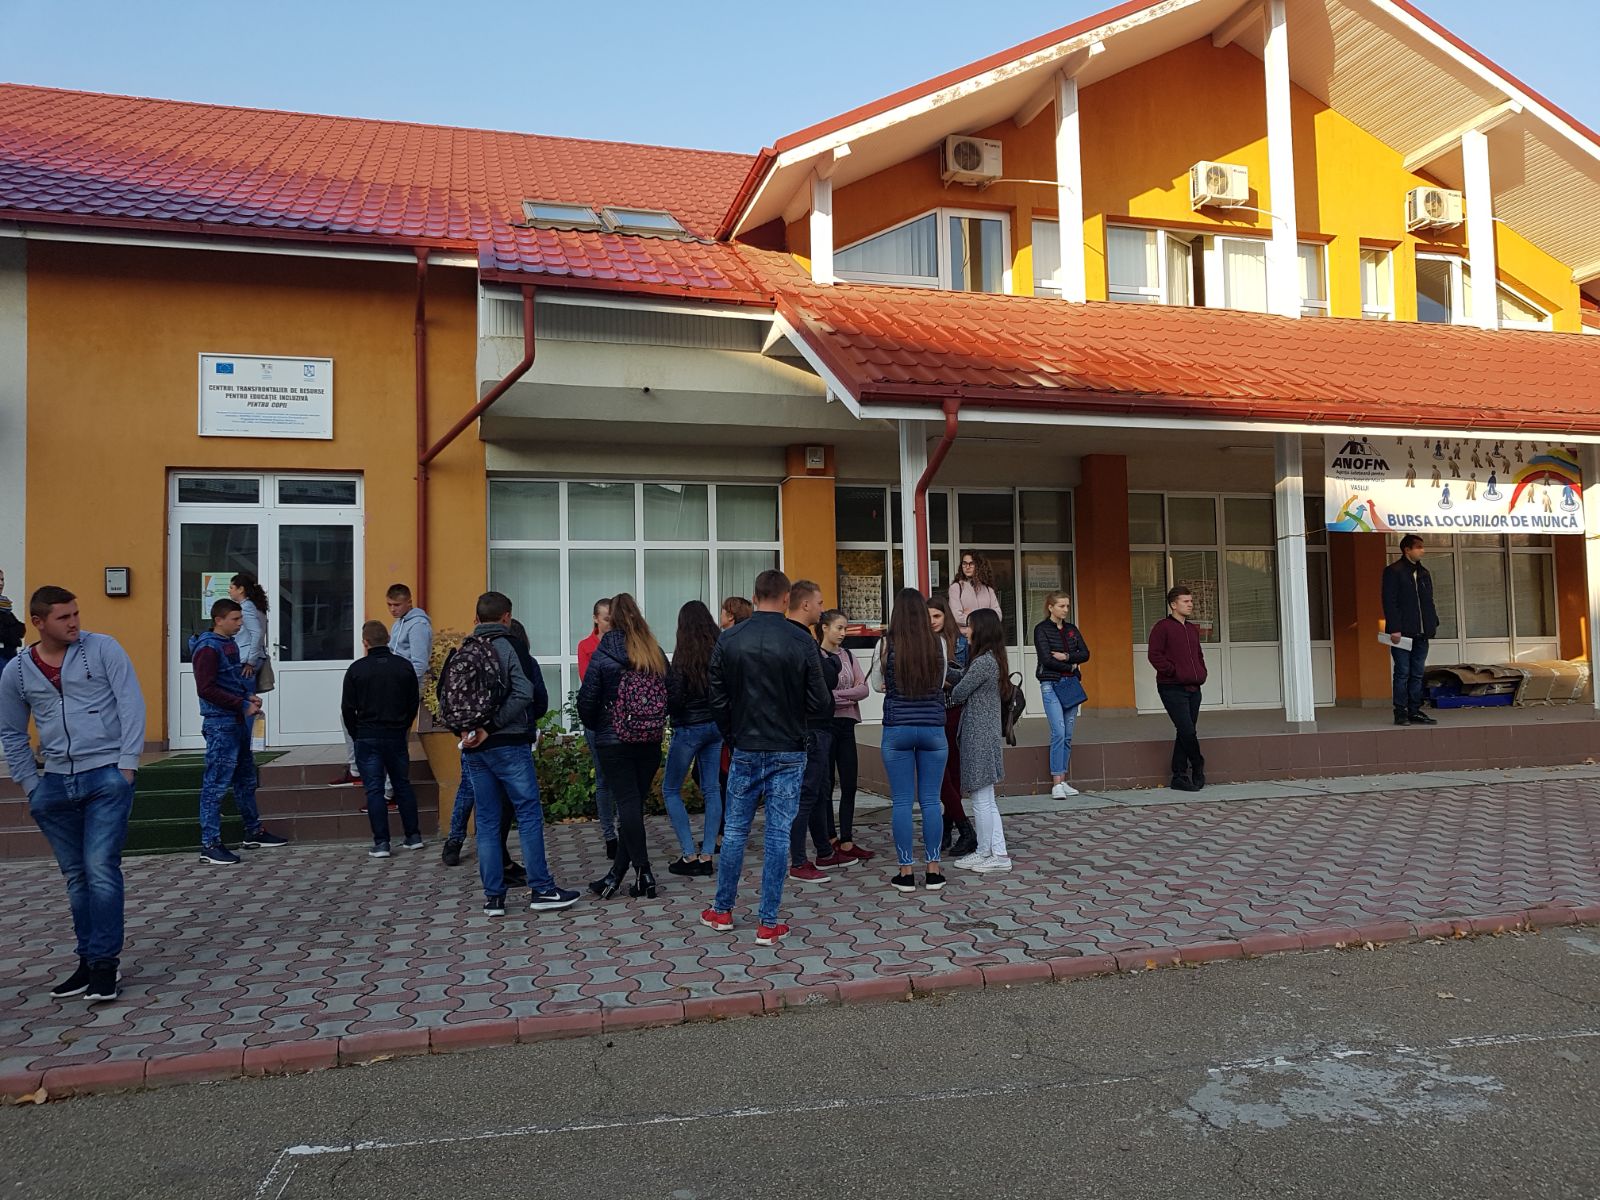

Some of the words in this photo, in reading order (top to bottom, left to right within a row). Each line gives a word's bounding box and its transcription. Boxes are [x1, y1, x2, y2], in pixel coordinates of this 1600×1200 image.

[299, 387, 325, 395] RESURSE
[1331, 457, 1390, 470] ANOFM
[1387, 513, 1434, 527] BURSA
[1435, 514, 1509, 528] LOCURILOR
[1510, 515, 1530, 528] DE
[1531, 513, 1579, 528] MUNCĂ
